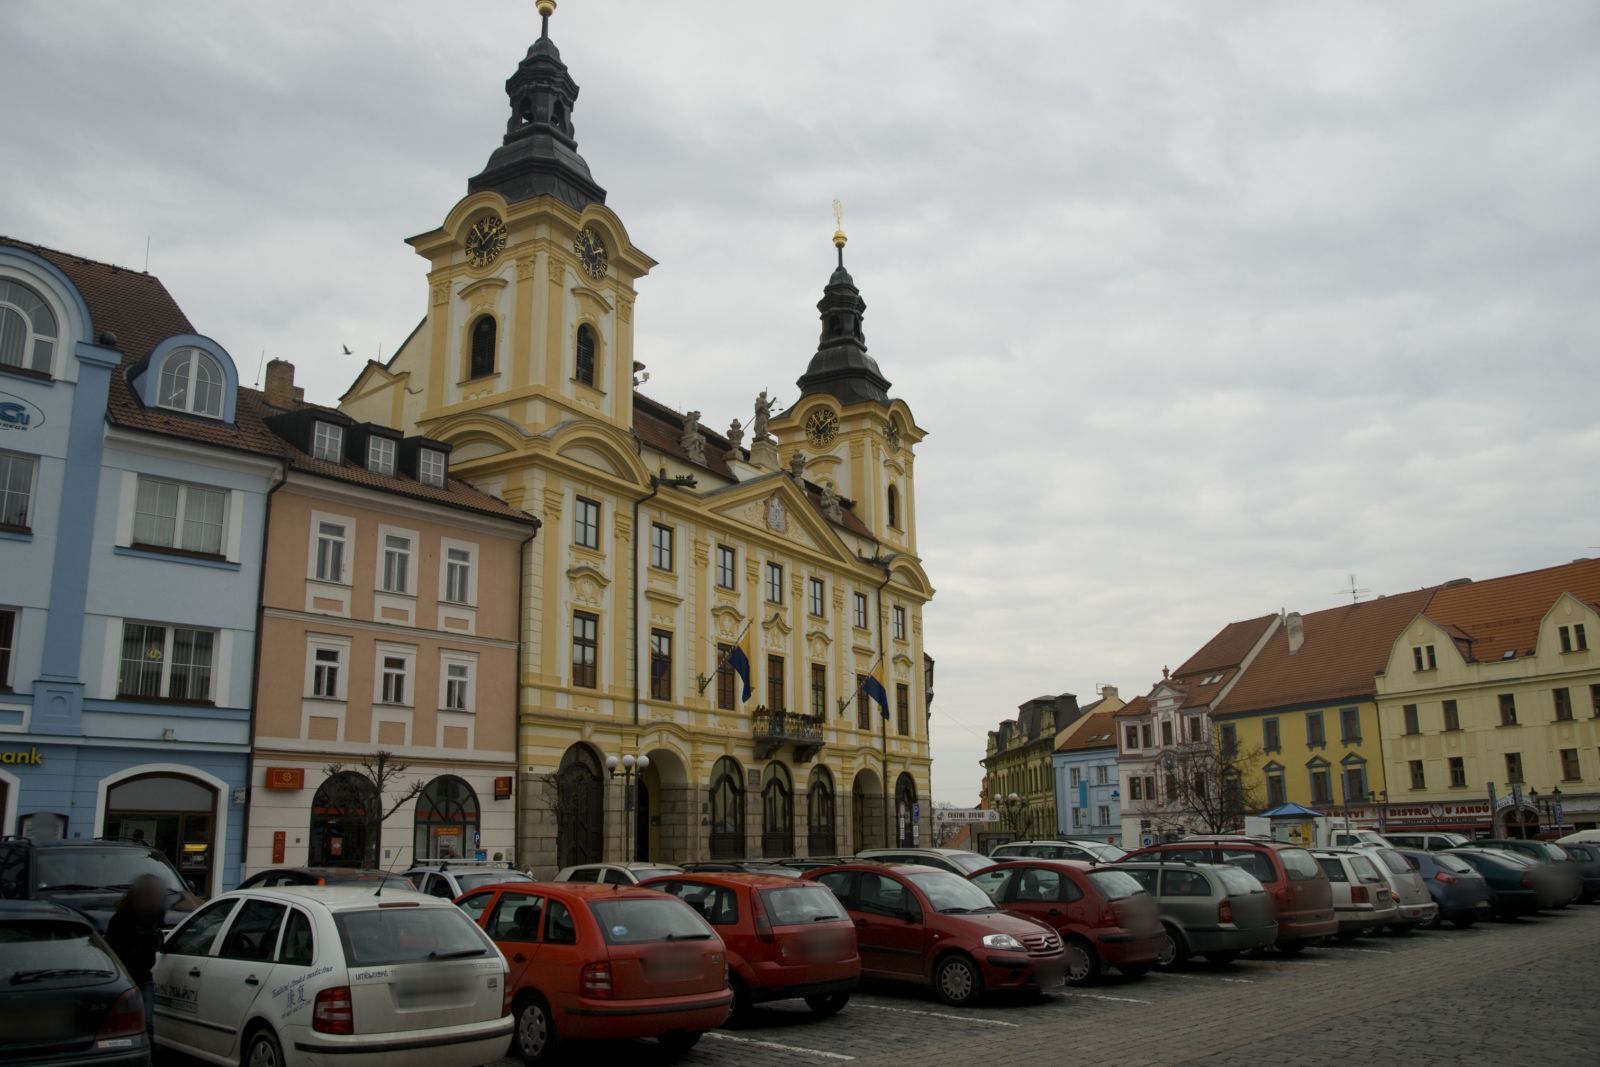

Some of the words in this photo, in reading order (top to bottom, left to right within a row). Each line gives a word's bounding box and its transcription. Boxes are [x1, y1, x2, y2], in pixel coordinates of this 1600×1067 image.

[0, 746, 42, 764] ank
[1390, 807, 1429, 817] BISTRO
[1445, 806, 1452, 815] U
